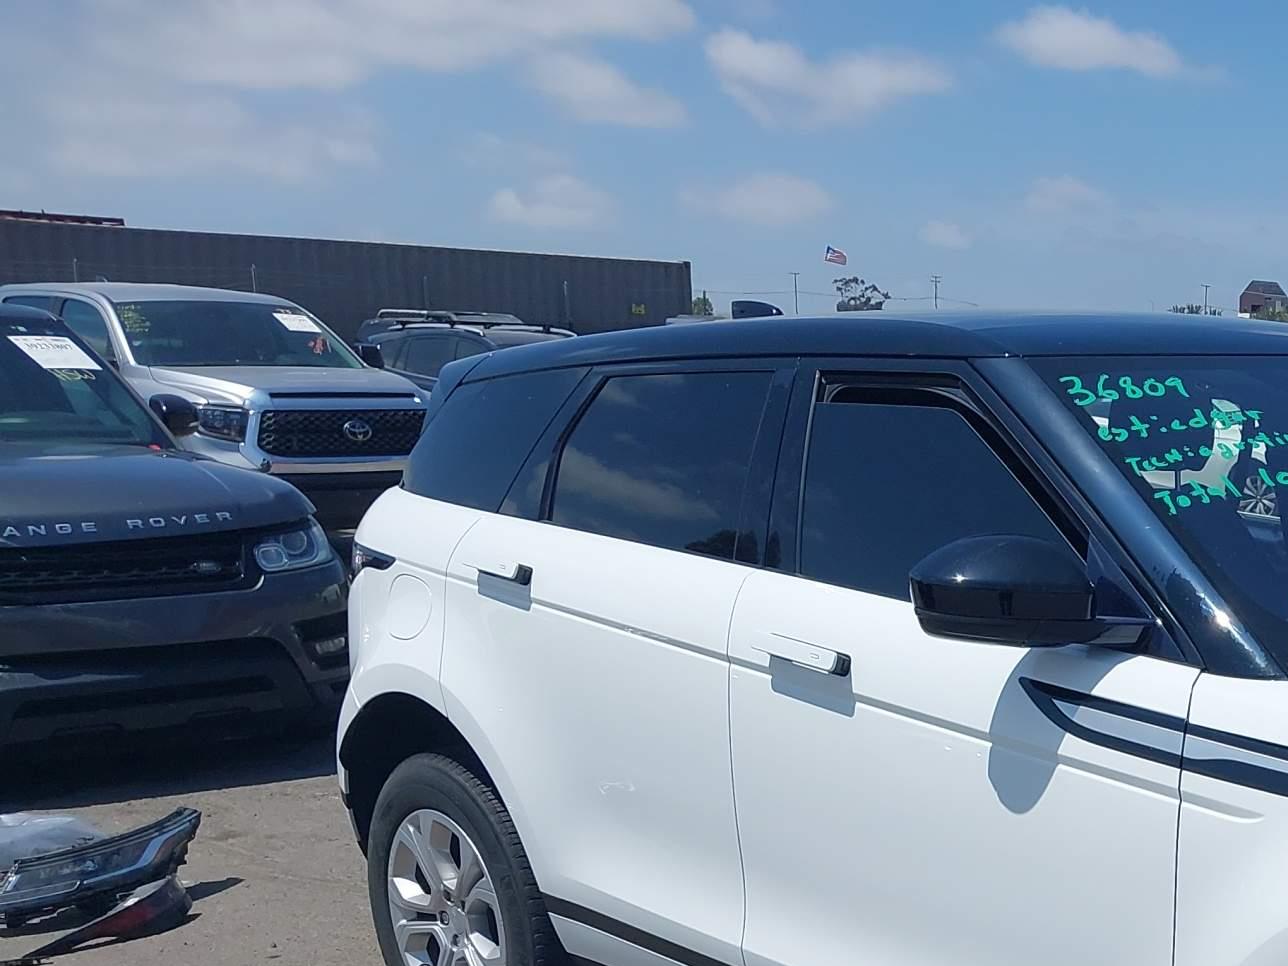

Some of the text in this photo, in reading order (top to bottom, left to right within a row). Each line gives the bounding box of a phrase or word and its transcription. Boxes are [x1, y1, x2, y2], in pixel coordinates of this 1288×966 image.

[1059, 374, 1190, 406] 36809
[2, 511, 233, 537] ANGE ROVER
